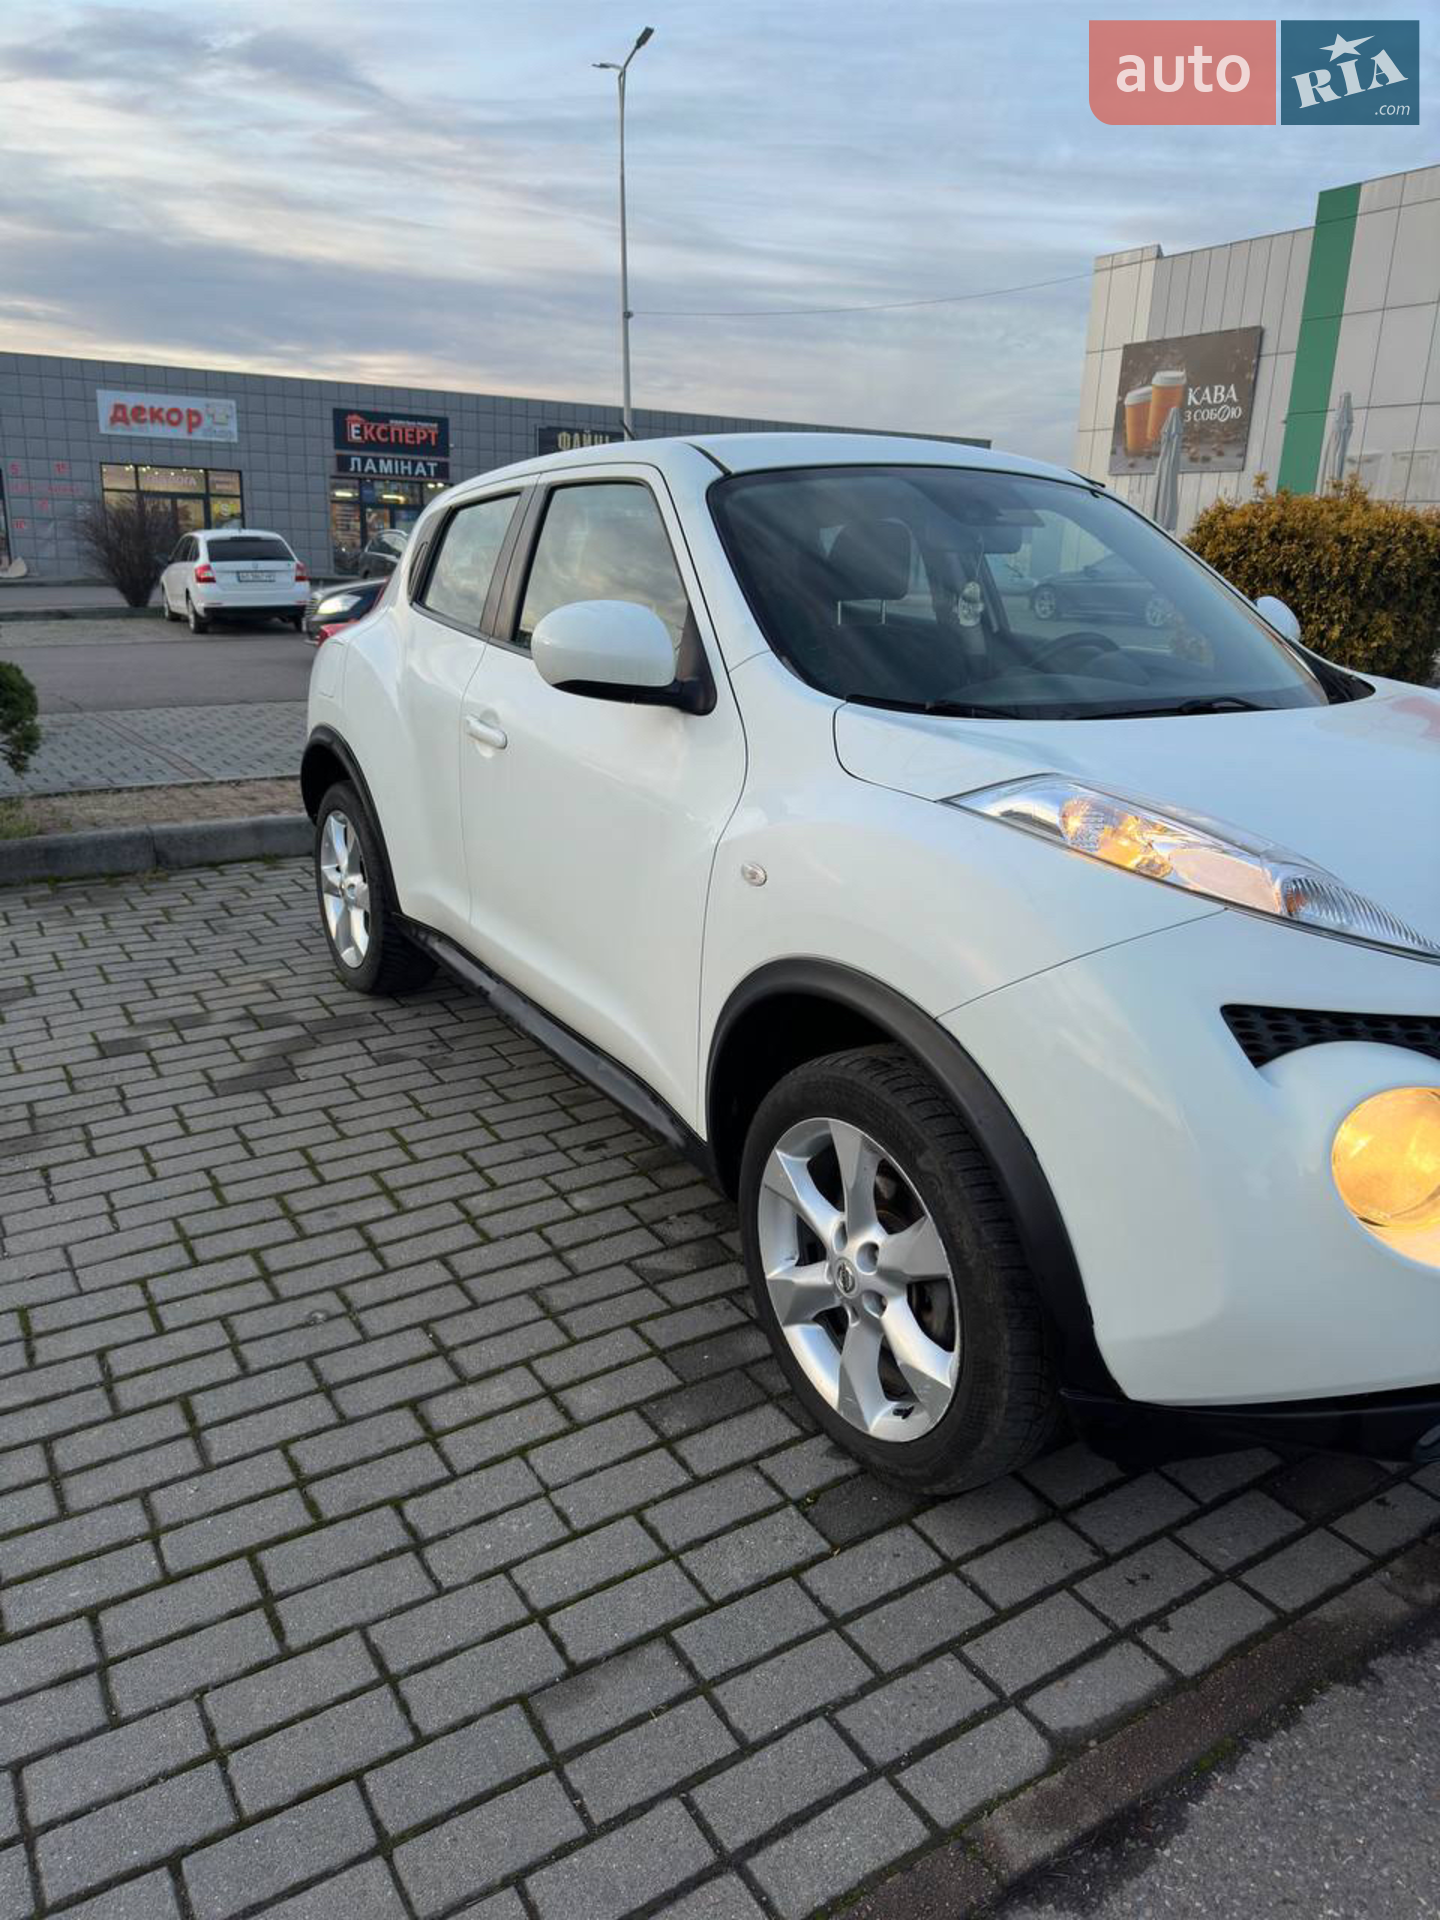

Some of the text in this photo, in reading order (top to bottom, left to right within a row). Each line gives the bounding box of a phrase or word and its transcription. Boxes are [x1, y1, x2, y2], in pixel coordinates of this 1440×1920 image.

[1187, 384, 1237, 406] КАВА
[110, 403, 202, 433] декор
[350, 423, 438, 446] ЕКСПЕРТ
[349, 457, 438, 477] ЛАМІНАТ
